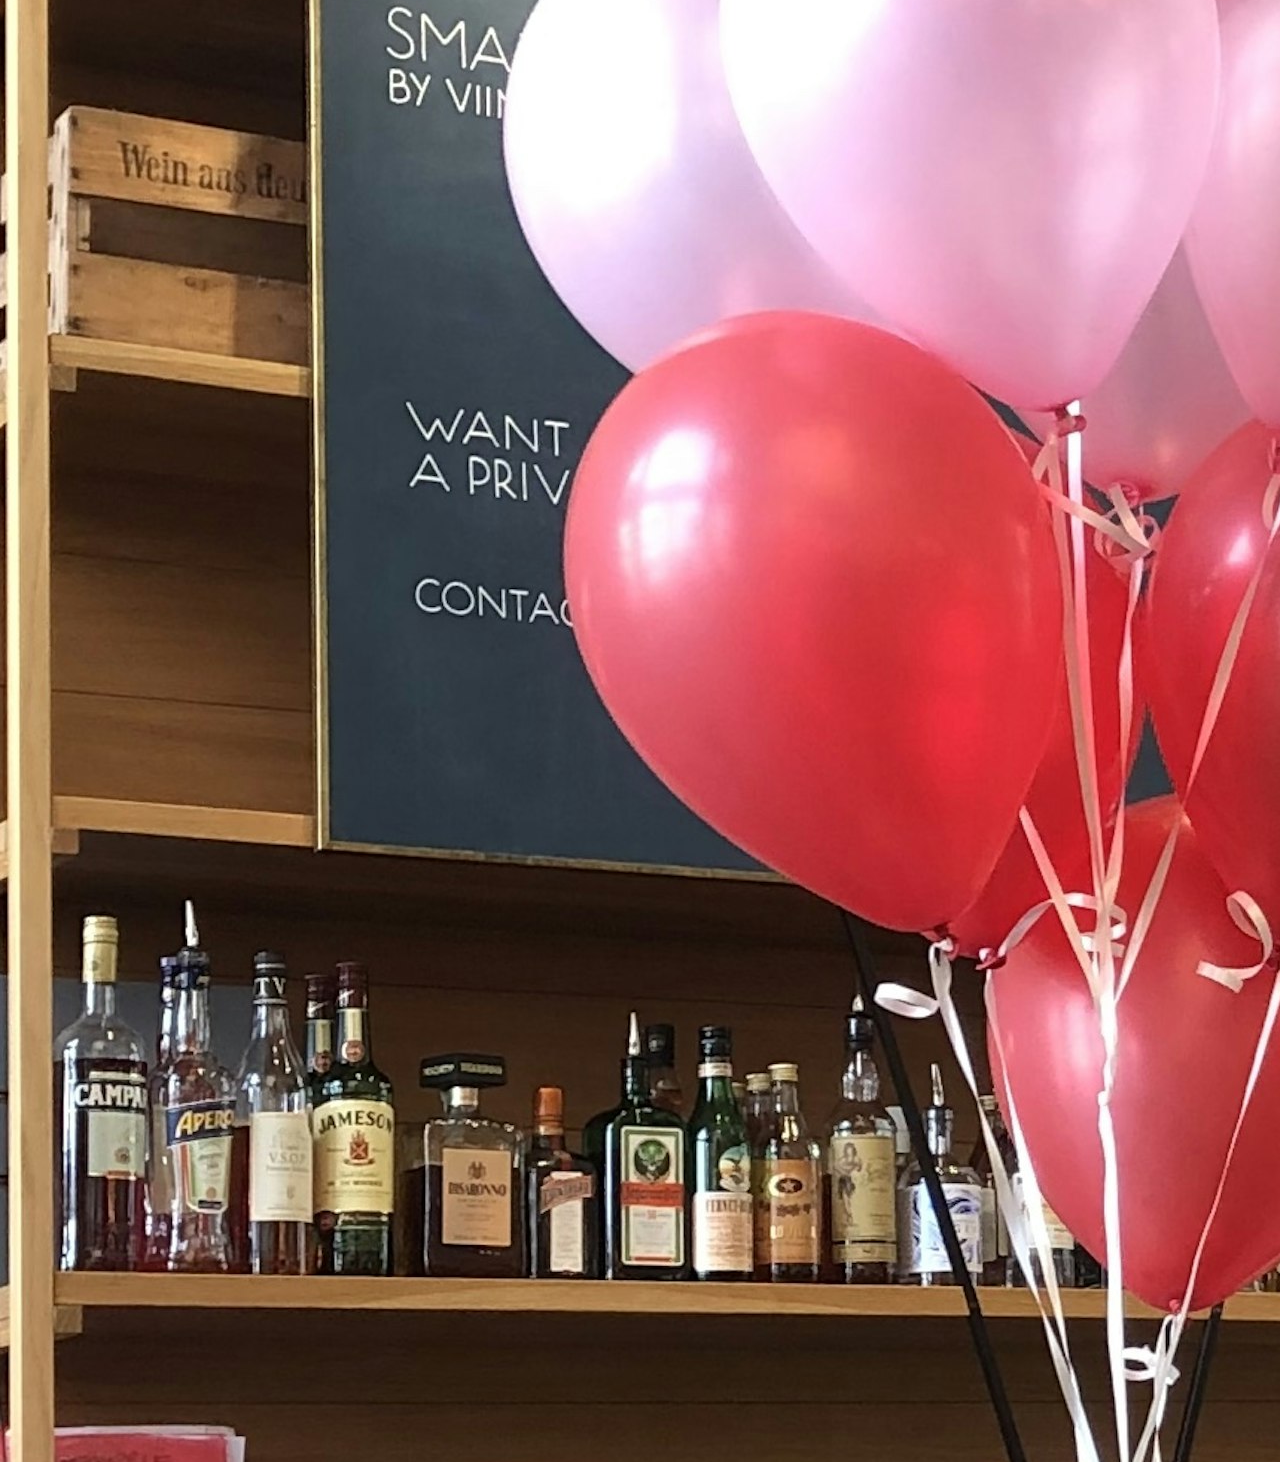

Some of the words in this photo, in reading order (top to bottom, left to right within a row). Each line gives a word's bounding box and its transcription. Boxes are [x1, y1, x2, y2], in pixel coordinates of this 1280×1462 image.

[386, 7, 511, 73] SMA
[389, 68, 431, 106] BY
[118, 140, 190, 187] Wein
[406, 401, 570, 457] WANT
[409, 453, 450, 492] A
[468, 455, 570, 505] PRIV
[175, 1108, 235, 1138] APERO
[318, 1108, 392, 1135] JAMESON
